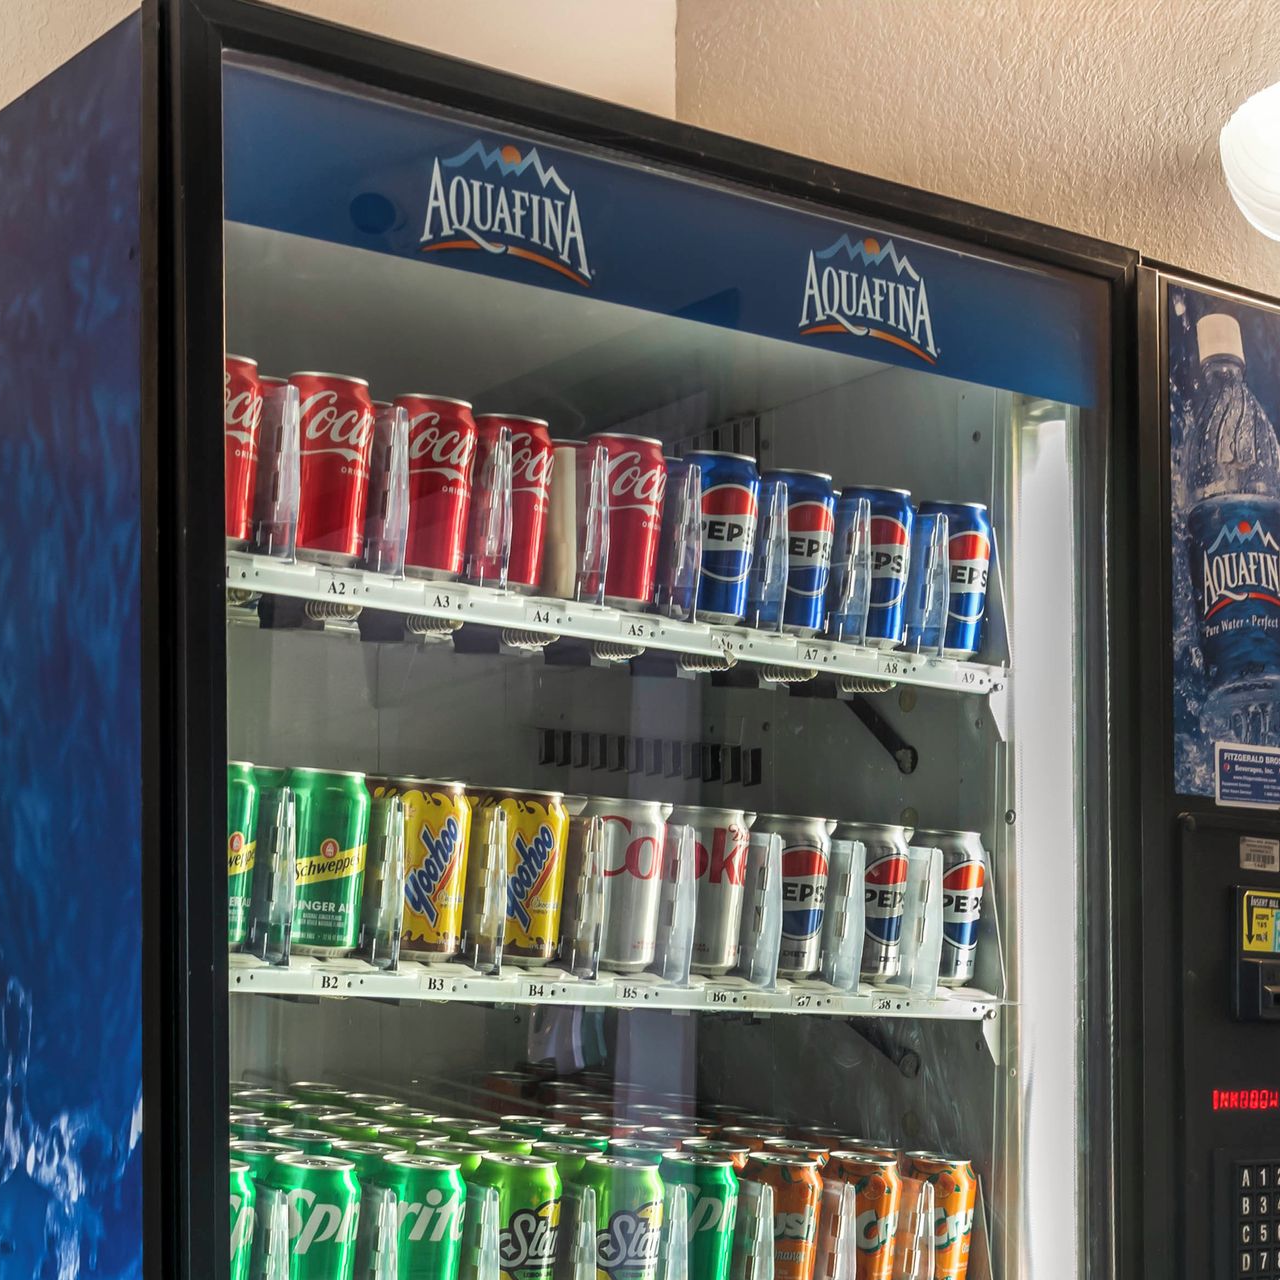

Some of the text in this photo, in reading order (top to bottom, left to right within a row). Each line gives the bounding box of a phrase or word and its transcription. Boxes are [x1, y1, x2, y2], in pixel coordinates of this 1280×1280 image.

[420, 157, 589, 280] AQUAFINA
[798, 249, 937, 354] AQUAFINA
[327, 582, 346, 595] A2
[433, 595, 450, 608] A3
[533, 610, 550, 623] A4
[627, 624, 644, 636] A5
[1205, 625, 1220, 638] Pure
[1221, 619, 1244, 632] Water
[1251, 614, 1279, 631] Perfect
[803, 649, 818, 661] A7
[884, 662, 898, 674] A8
[961, 673, 975, 684] A9
[1223, 752, 1264, 764] FITZGERALD
[1251, 895, 1268, 907] INSERT
[1269, 898, 1279, 909] BILL
[321, 975, 339, 989] B2
[428, 977, 445, 990] B3
[528, 984, 544, 997] B4
[1242, 1169, 1251, 1187] A
[1260, 1168, 1266, 1186] 1
[1243, 1197, 1250, 1215] B
[1260, 1196, 1267, 1214] 3
[1243, 1225, 1250, 1243] C
[1260, 1224, 1267, 1242] 5
[1242, 1253, 1251, 1271] D
[1260, 1252, 1267, 1270] 7
